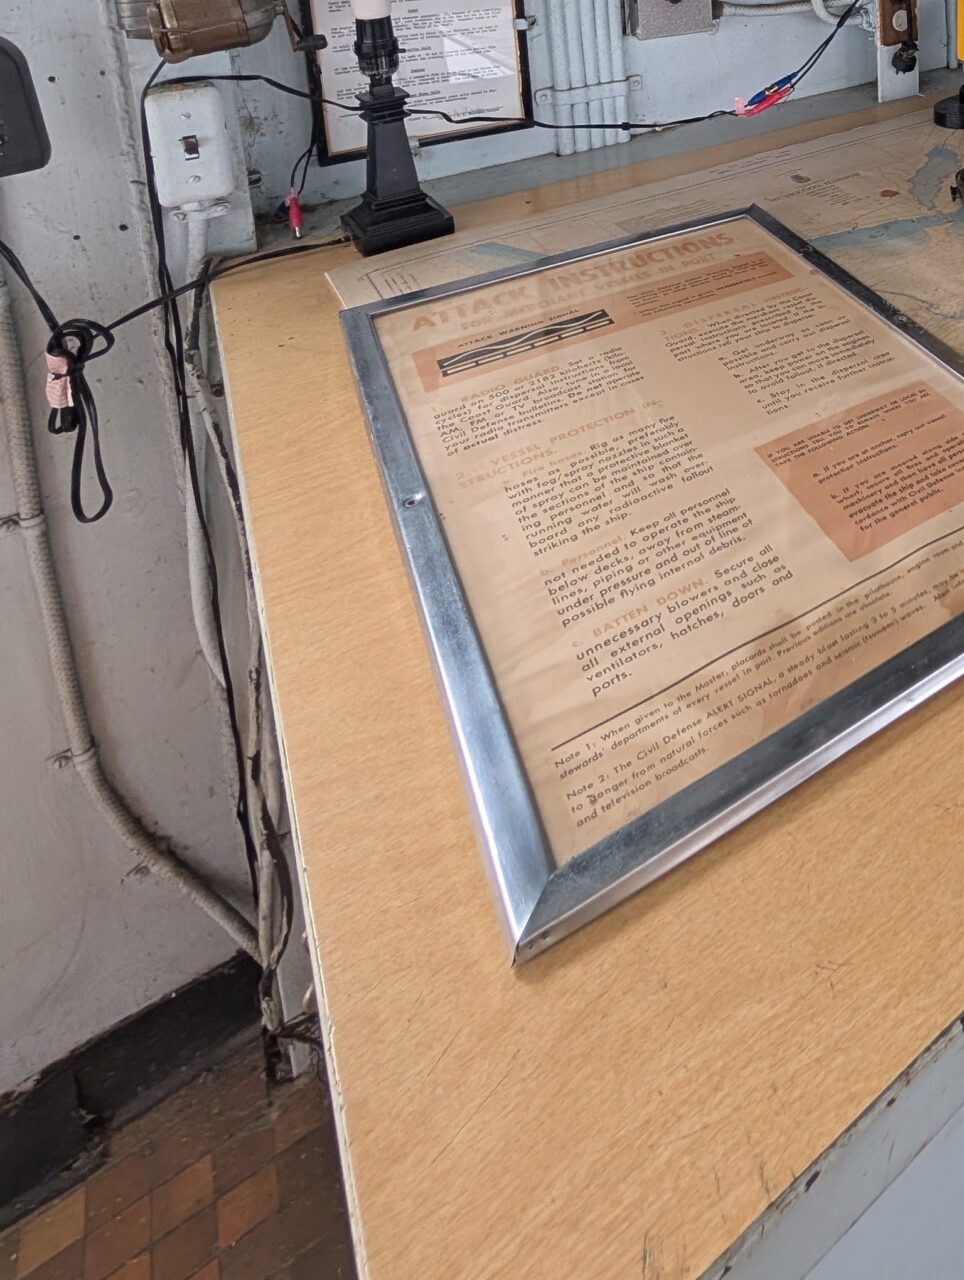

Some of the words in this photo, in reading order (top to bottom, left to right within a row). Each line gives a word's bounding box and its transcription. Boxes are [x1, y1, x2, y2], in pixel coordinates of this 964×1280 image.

[412, 285, 527, 332] ATTACK
[547, 233, 735, 293] INSTRUCTIONS
[460, 316, 493, 331] FOR
[504, 289, 587, 320] MERCHANT
[457, 335, 492, 348] ATTACK
[499, 320, 545, 336] WARNING
[548, 308, 580, 322] SIGNAL
[432, 403, 466, 420] guard
[470, 398, 484, 406] on
[488, 389, 510, 400] 500
[528, 373, 556, 386] 2182
[558, 359, 601, 375] kilohertz
[603, 352, 625, 361] (kilo-
[441, 430, 466, 443] Civil
[470, 414, 515, 433] Defense
[517, 398, 564, 416] bulletins.
[586, 382, 602, 392] not
[605, 370, 640, 385] operate
[459, 383, 506, 402] RADIO
[567, 358, 582, 366] Set
[598, 346, 622, 356] radio
[446, 447, 458, 456] of
[462, 432, 499, 451] actual
[502, 418, 545, 436] distress.
[503, 476, 538, 493] hoses
[547, 467, 560, 475] as
[569, 446, 619, 468] possible,
[627, 421, 679, 445] preferably
[507, 486, 532, 499] with
[536, 462, 593, 488] fog/spray
[597, 445, 638, 464] nozzles
[653, 431, 675, 442] such
[511, 486, 555, 508] manner
[558, 475, 582, 488] that
[597, 449, 650, 474] protective
[651, 432, 688, 451] blanket
[525, 516, 573, 539] running
[580, 498, 613, 515] water
[621, 485, 641, 498] will
[648, 472, 677, 486] wash
[528, 526, 568, 548] board
[576, 514, 599, 527] any
[608, 483, 673, 514] radioactive
[680, 465, 713, 483] fallout
[859, 522, 872, 531] for
[873, 515, 887, 524] the
[888, 498, 918, 518] general
[533, 533, 578, 557] striking
[580, 524, 600, 535] the
[547, 573, 588, 596] below
[593, 555, 634, 575] decks,
[637, 536, 670, 555] away
[674, 521, 704, 538] from
[707, 505, 741, 524] steam-
[561, 596, 615, 628] possible
[619, 578, 656, 598] flying
[657, 551, 704, 580] internal
[575, 611, 661, 661] unnecessary
[665, 585, 719, 614] blowers
[723, 569, 748, 586] and
[751, 555, 779, 572] close
[591, 603, 648, 637] BATTEN
[713, 555, 754, 579] Secure
[758, 543, 773, 556] all
[585, 642, 663, 681] ventilators,
[669, 610, 724, 640] hatches,
[731, 586, 765, 608] doors
[771, 569, 793, 586] and
[591, 671, 632, 697] ports.
[566, 782, 593, 800] Note
[612, 760, 632, 774] The
[635, 741, 660, 761] Civil
[661, 718, 701, 745] Defense
[706, 699, 733, 718] ALERT
[736, 677, 776, 702] SIGNAL,
[610, 714, 669, 750] departments
[575, 807, 598, 828] and
[600, 779, 652, 812] television
